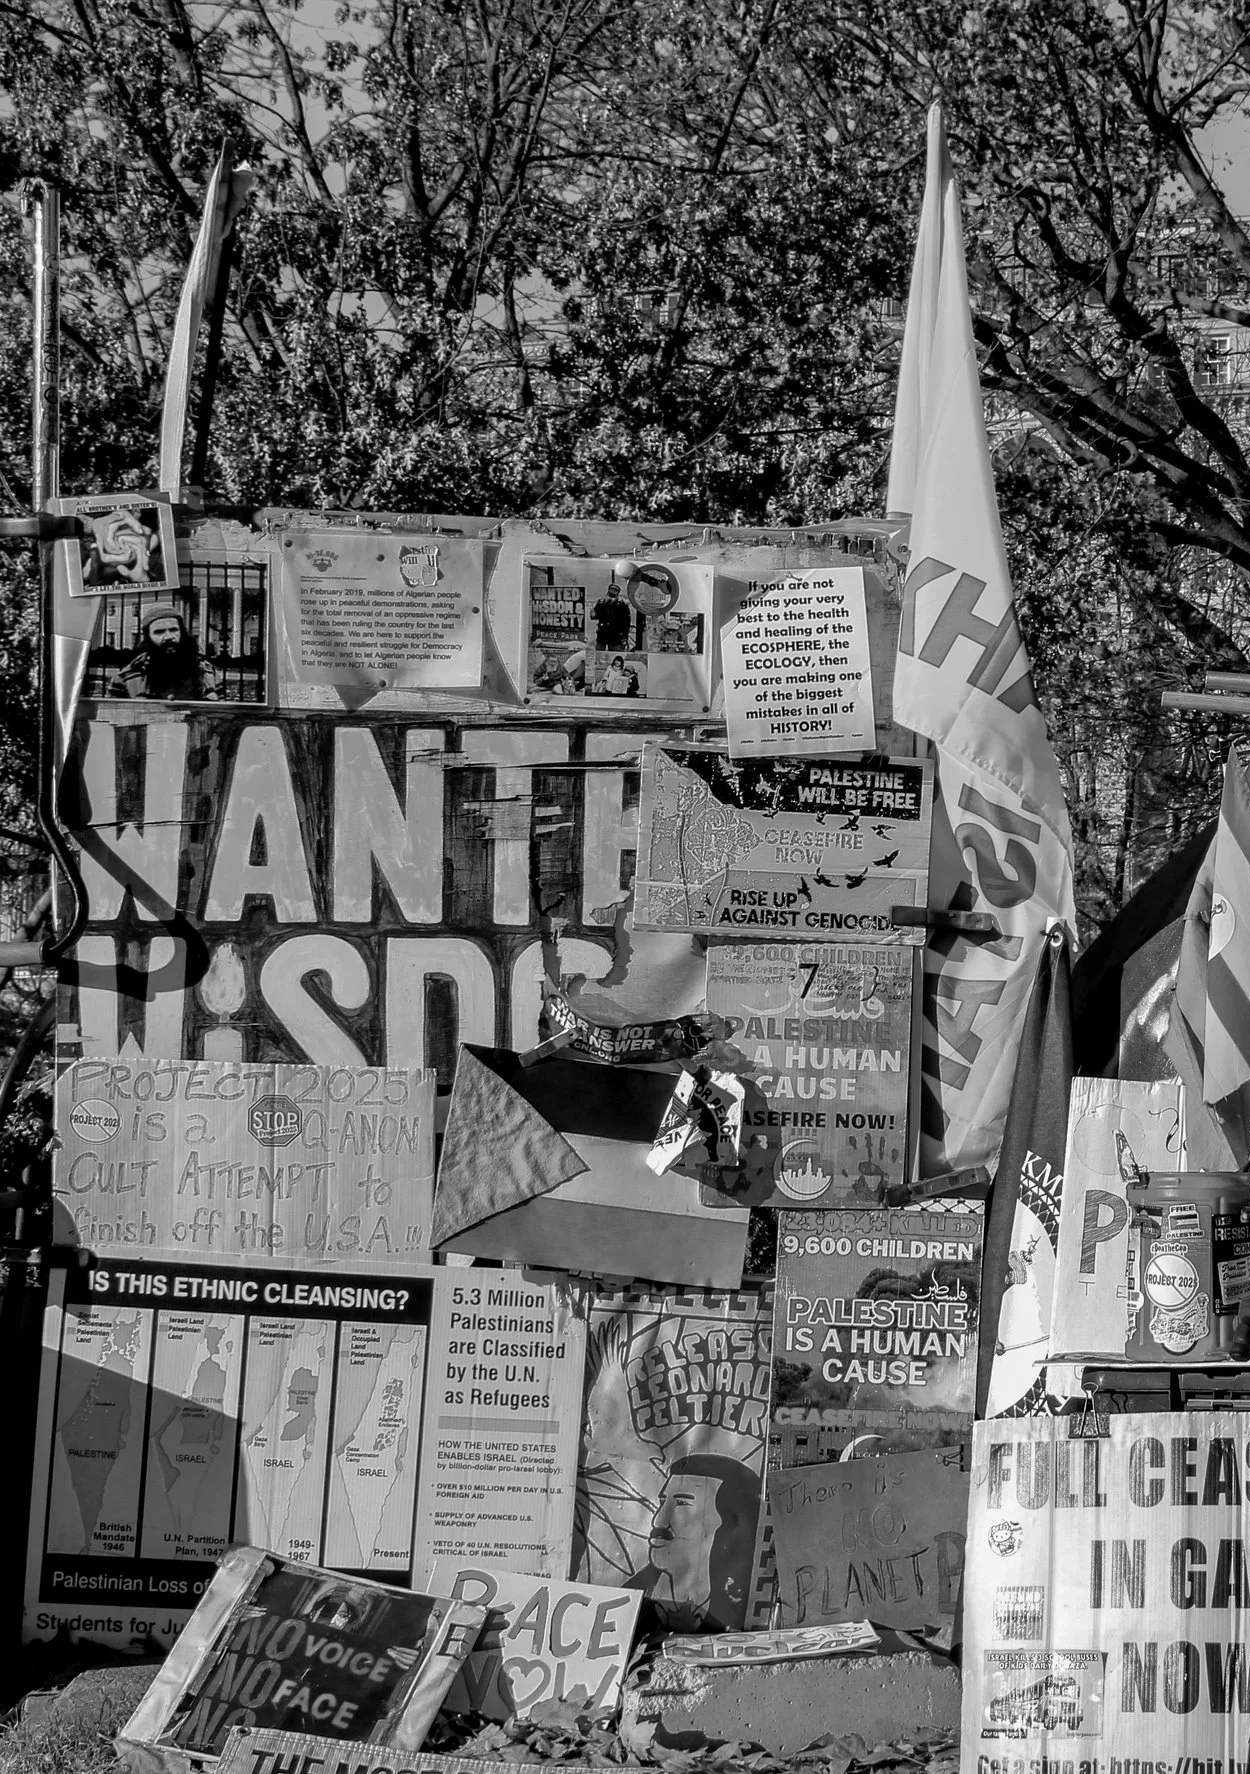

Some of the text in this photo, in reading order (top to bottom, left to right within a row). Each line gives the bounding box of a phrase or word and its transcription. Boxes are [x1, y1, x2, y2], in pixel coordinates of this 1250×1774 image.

[310, 588, 342, 596] February
[749, 581, 758, 591] If
[761, 582, 784, 593] you
[813, 579, 834, 589] not
[740, 595, 844, 609] giving your very
[737, 608, 849, 623] best to the health
[742, 639, 850, 654] ECOSPHERE, the
[746, 656, 848, 670] ECOLOGY, then
[771, 720, 832, 734] HISTORY!
[810, 767, 904, 789] PALESTINE
[798, 786, 916, 810] WILL BE FREE
[764, 829, 864, 850] CEASEFIRE
[775, 847, 824, 865] NOW
[730, 889, 797, 908] RISE UP
[719, 908, 800, 926] AGAINST
[801, 949, 901, 966] CHILDREN
[594, 1027, 612, 1040] IS
[617, 1026, 653, 1040] NOT
[724, 1016, 891, 1042] PALESTINE
[754, 1045, 901, 1072] A HUMAN
[73, 1061, 410, 1106] PROJECT 2025
[755, 1075, 856, 1100] CAUSE
[132, 1106, 168, 1142] is
[185, 1114, 216, 1144] a
[253, 1112, 298, 1129] STOP
[836, 1113, 895, 1130] NOW!
[359, 1164, 392, 1207] to
[70, 1206, 157, 1244] finish
[173, 1208, 221, 1243] off
[234, 1211, 284, 1248] the
[784, 1236, 973, 1260] 9,600 CHILDREN
[88, 1270, 410, 1311] IS THIS ETHNIC CLEANSING?
[452, 1288, 545, 1308] 5.3 Million
[451, 1312, 554, 1333] Palestinians
[787, 1297, 967, 1330] PALESTINE
[449, 1339, 565, 1358] are Classified
[786, 1327, 965, 1357] IS A HUMAN
[447, 1362, 540, 1383] by the U.N.
[822, 1358, 927, 1385] CAUSE
[444, 1388, 550, 1410] as Refugees
[637, 1394, 764, 1436] PELTIER
[68, 1449, 117, 1460] PALESTINE
[439, 1440, 556, 1452] HOW THE UNITED STATES
[263, 1458, 294, 1468] ISRAEL
[438, 1451, 516, 1462] ENABLES ISRAEL
[986, 1440, 1107, 1509] FULL
[93, 1532, 135, 1543] Mandate
[100, 1523, 132, 1532] British
[103, 1542, 125, 1551] 1946
[163, 1534, 226, 1545] U.N. Partition
[175, 1546, 200, 1557] Plan,
[373, 1548, 410, 1559] Present
[53, 1571, 210, 1594] Palestinian Loss of
[1091, 1539, 1146, 1609] IN
[36, 1614, 156, 1635] Students for
[304, 1634, 392, 1683] VOICE
[271, 1678, 360, 1729] FACE
